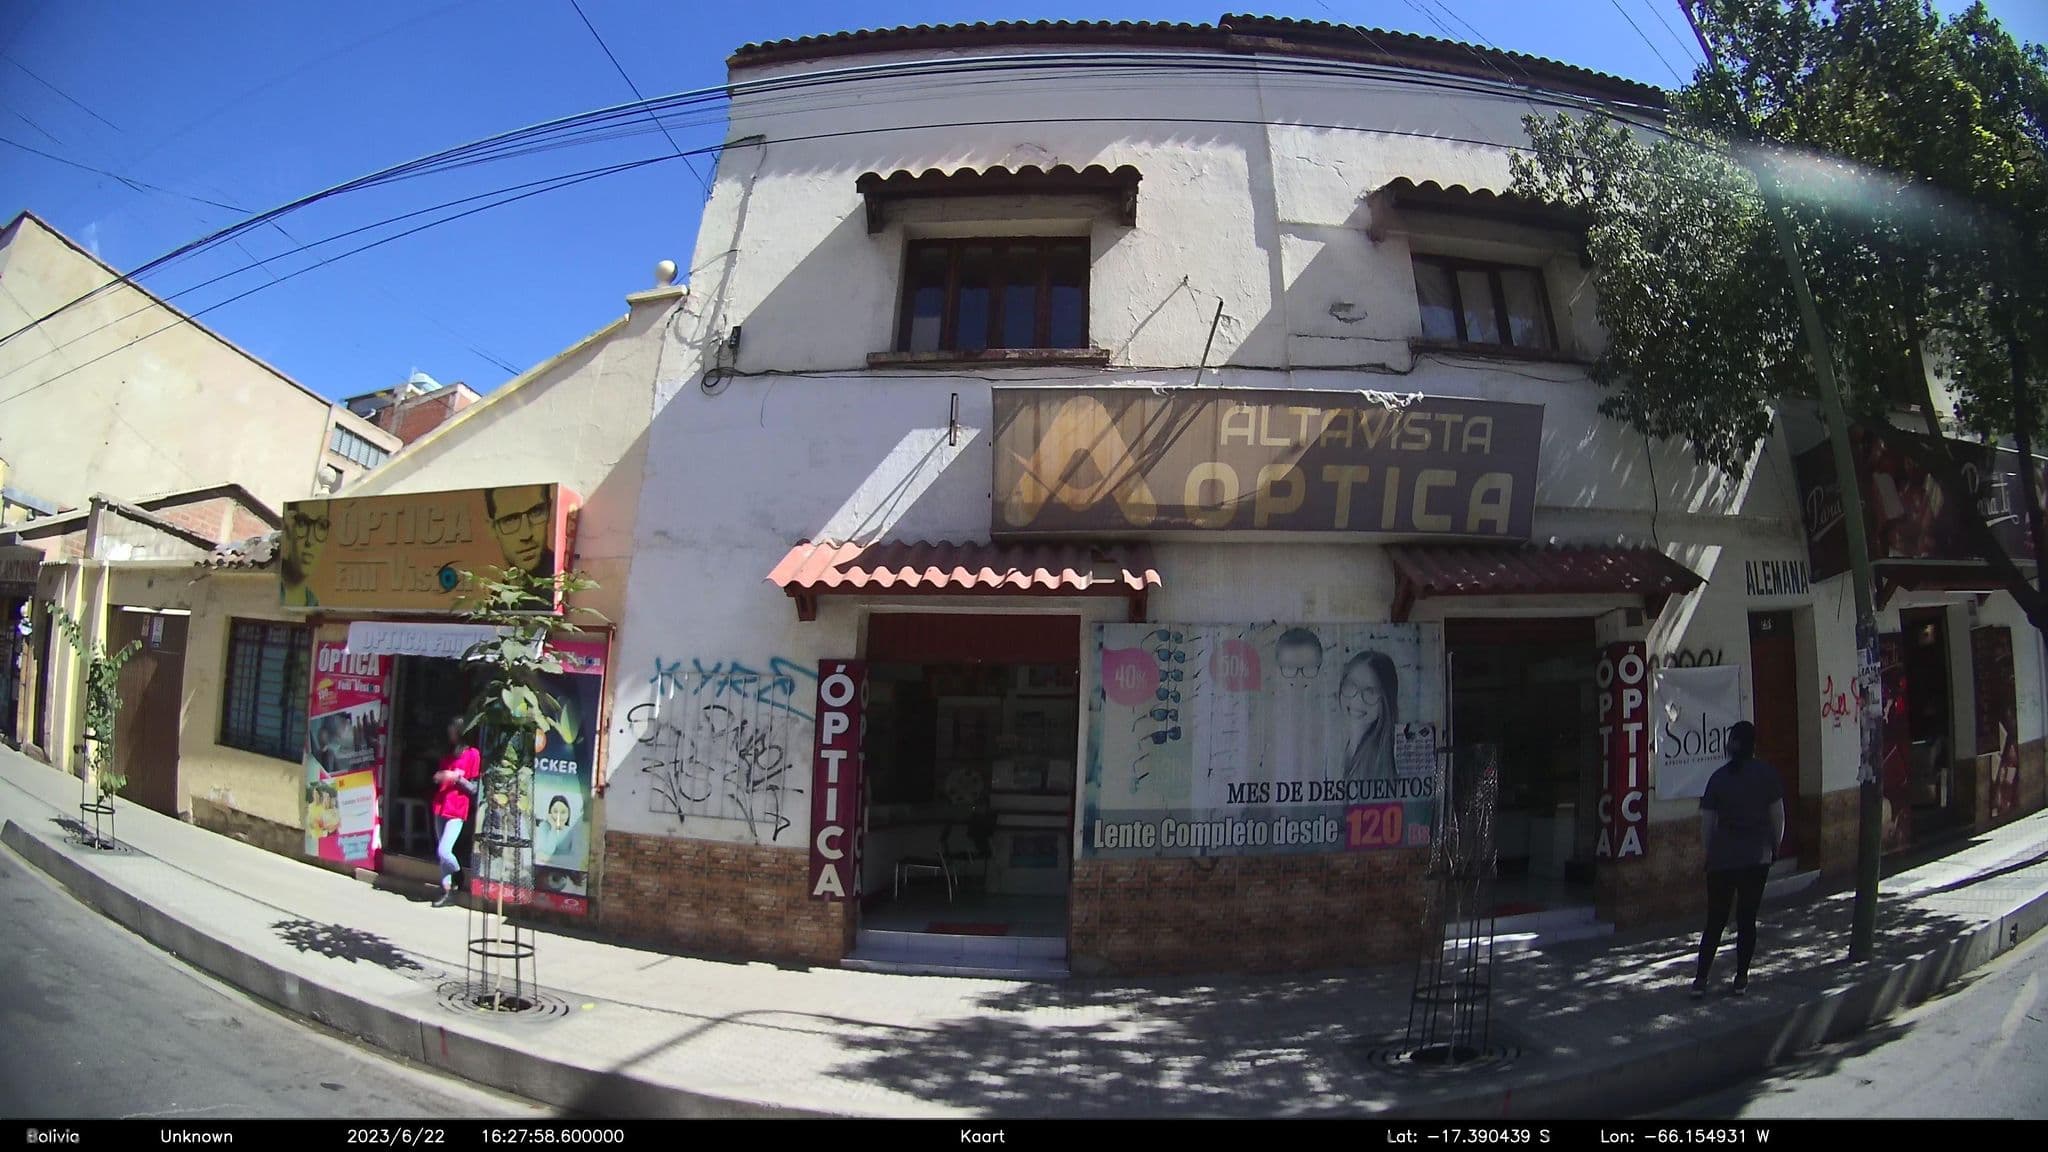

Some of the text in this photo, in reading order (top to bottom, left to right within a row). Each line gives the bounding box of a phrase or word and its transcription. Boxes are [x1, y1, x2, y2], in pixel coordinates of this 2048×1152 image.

[1219, 404, 1494, 455] ALTAVISTA
[1183, 461, 1513, 534] OPTICA
[336, 500, 473, 547] ÓPTICA
[1744, 560, 1809, 595] ALEMANA
[318, 643, 380, 677] ÓPTICA
[1594, 650, 1615, 858] ÓPTICA
[1616, 645, 1645, 858] ÓPTICA
[812, 663, 855, 897] ÓPTICA
[1227, 777, 1434, 804] MES DE DESCUENTOS
[1094, 818, 1156, 848] Lente
[1161, 816, 1269, 850] Completo
[1273, 815, 1339, 845] desde
[1347, 806, 1404, 847] 120
